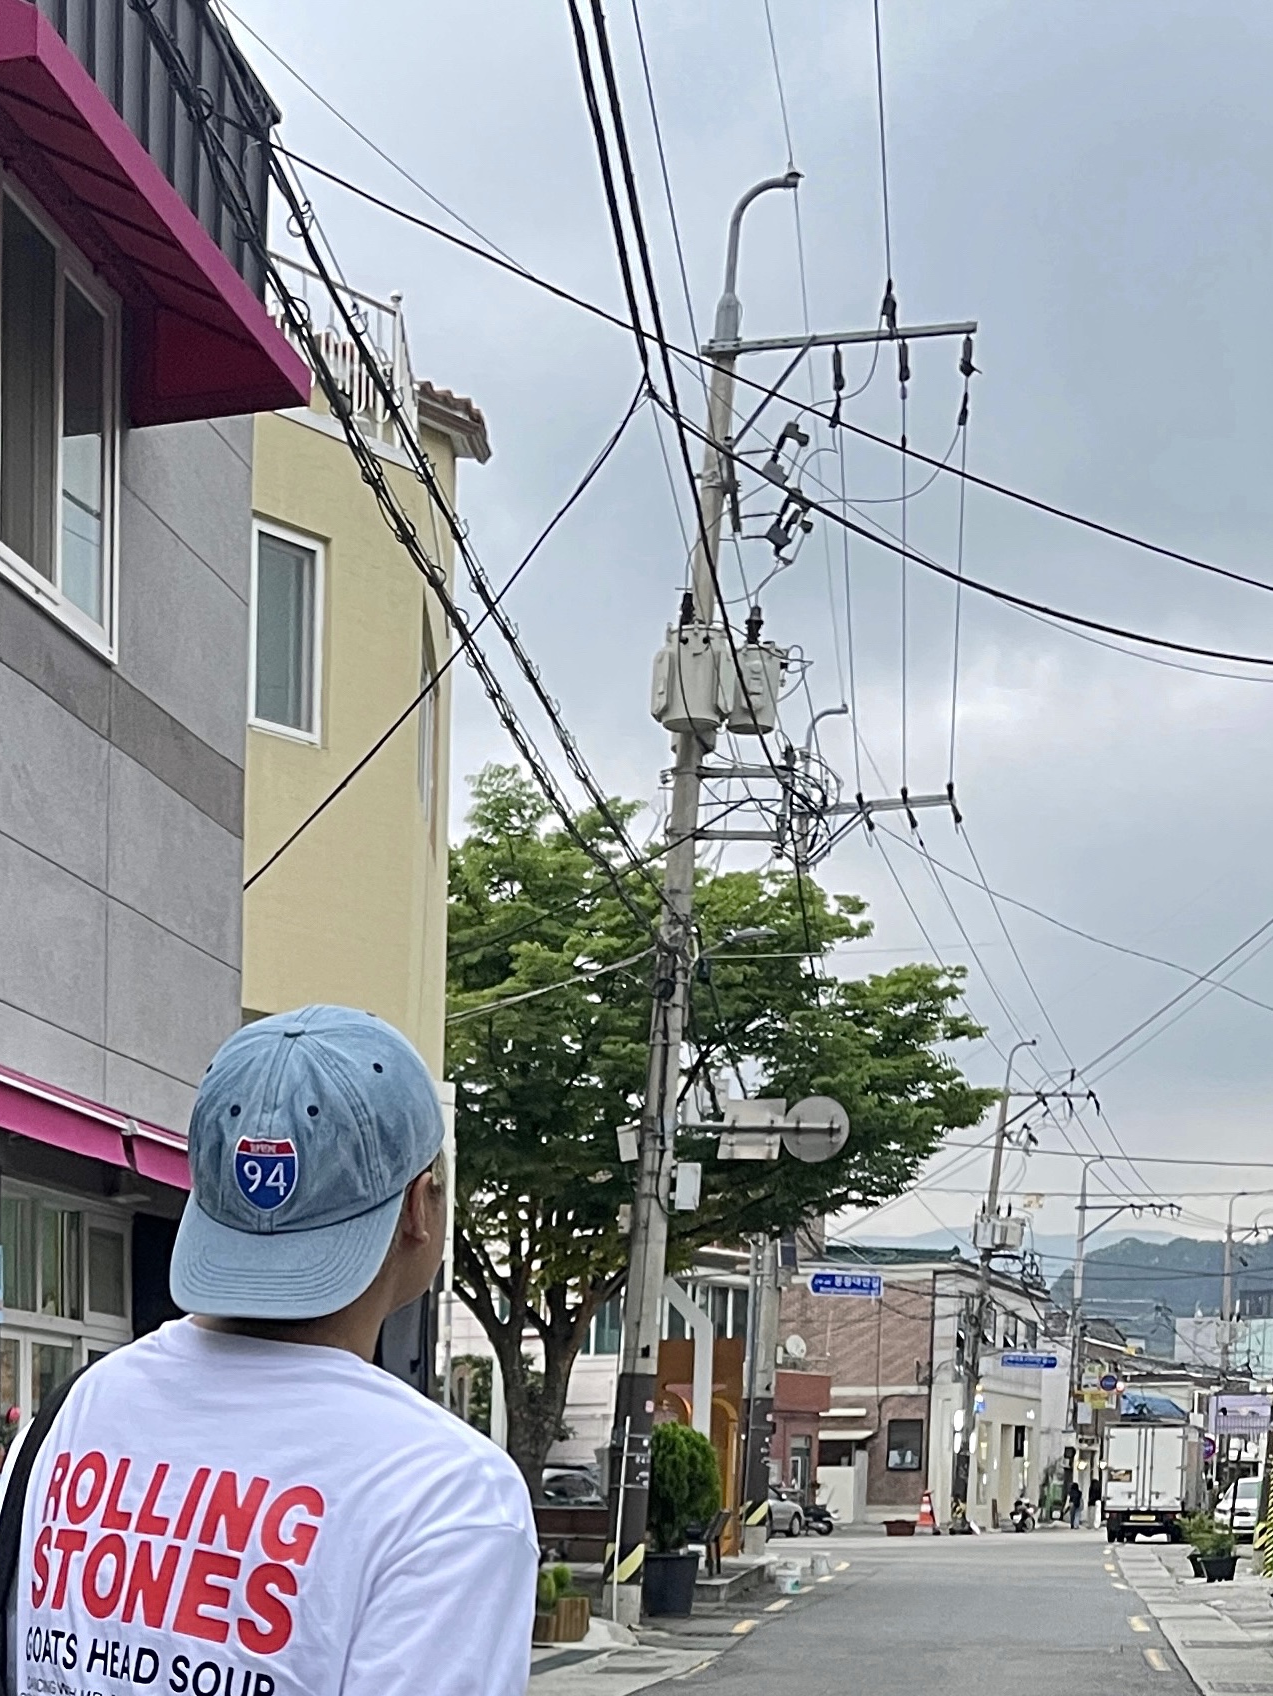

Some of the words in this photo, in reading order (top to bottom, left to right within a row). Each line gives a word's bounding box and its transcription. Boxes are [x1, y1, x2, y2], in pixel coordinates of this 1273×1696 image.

[243, 1160, 287, 1196] 94
[42, 1450, 325, 1566] ROLLING
[32, 1525, 298, 1655] STONES
[86, 1638, 160, 1685] HEAD
